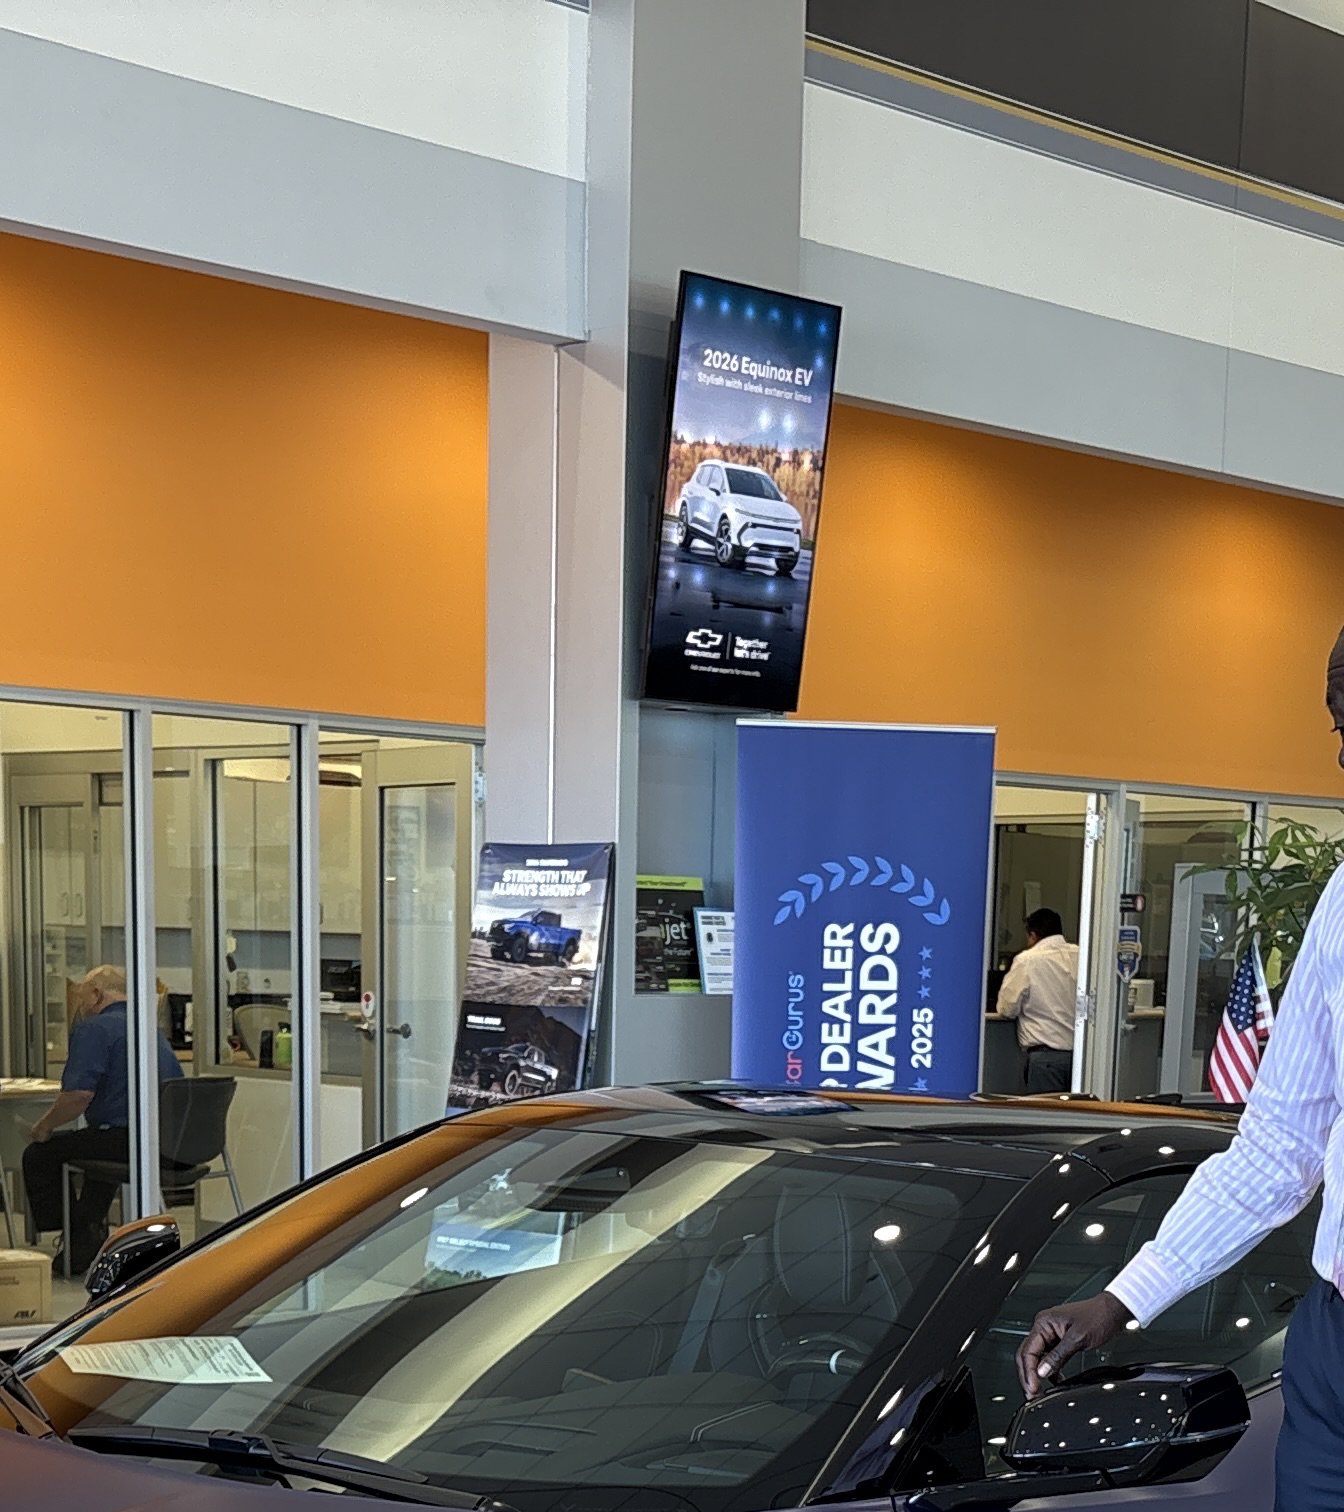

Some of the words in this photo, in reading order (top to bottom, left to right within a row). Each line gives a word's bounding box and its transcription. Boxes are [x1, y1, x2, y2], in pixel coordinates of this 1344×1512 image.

[703, 348, 739, 372] 2026
[741, 356, 794, 384] Equinox
[794, 367, 813, 387] EV
[697, 371, 725, 386] Stylish
[725, 377, 743, 390] with
[743, 381, 764, 394] sleek
[764, 386, 794, 400] exterior
[491, 881, 538, 897] ALWAYS
[538, 882, 576, 897] SHOWS
[502, 869, 560, 884] STRENGTH
[560, 870, 587, 884] THAT
[660, 918, 689, 945] jet
[820, 922, 855, 1072] DEALER
[782, 974, 805, 1085] arGurus
[911, 1007, 934, 1069] 2025
